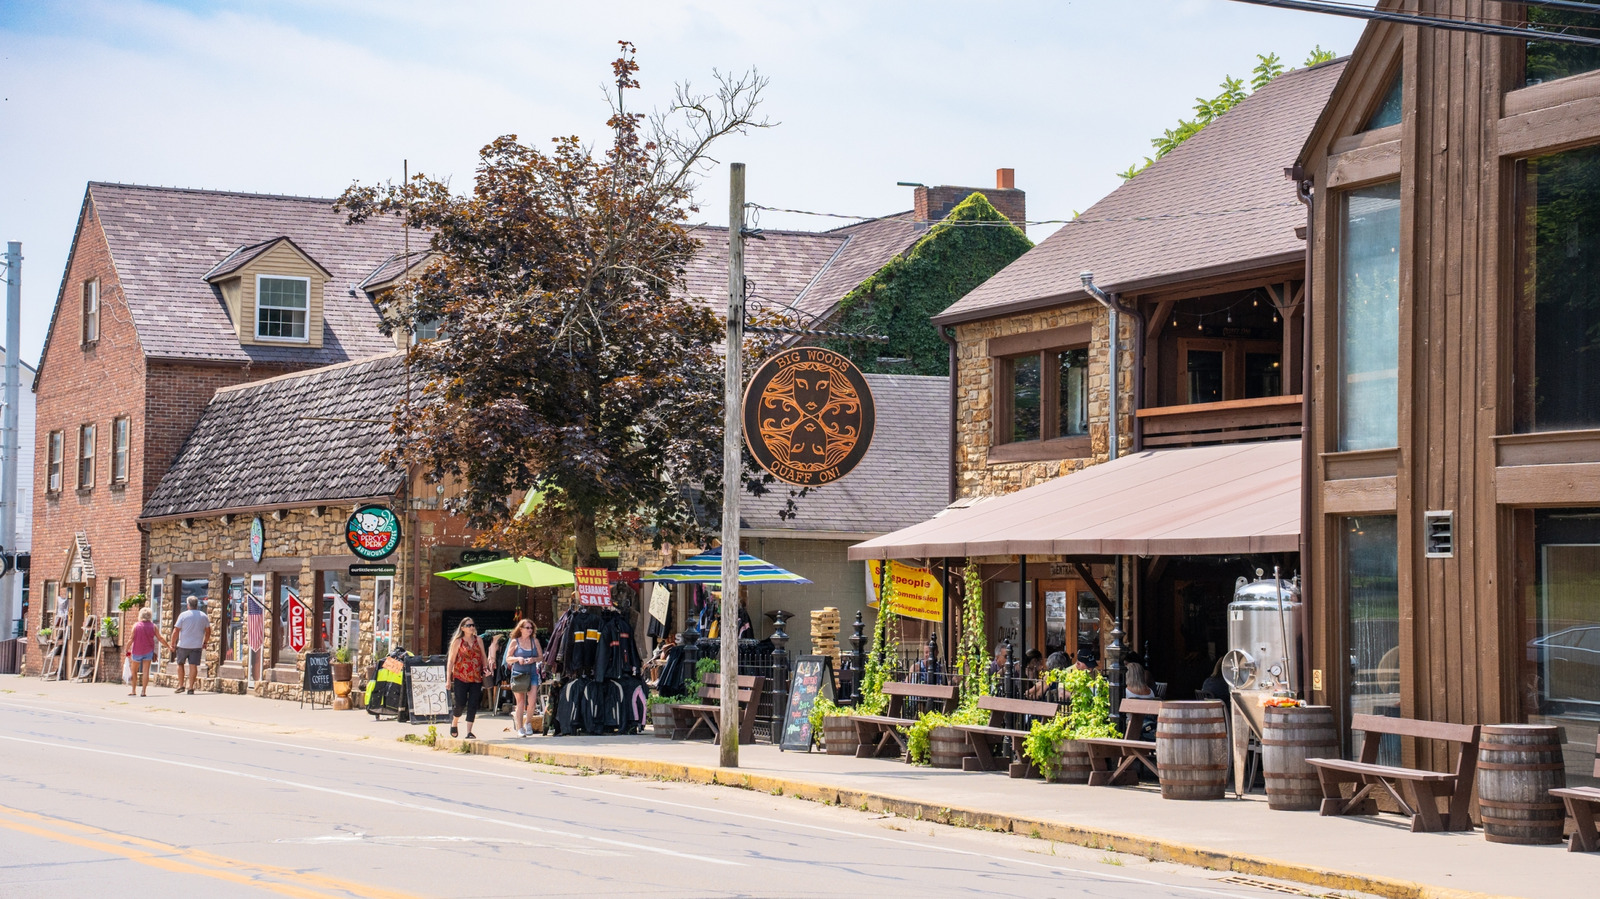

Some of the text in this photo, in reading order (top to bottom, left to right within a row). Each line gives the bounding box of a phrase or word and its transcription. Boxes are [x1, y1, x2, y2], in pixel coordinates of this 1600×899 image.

[775, 350, 850, 372] BIG WOODS
[769, 461, 841, 483] QUAFF ON!
[356, 530, 397, 557] ARTHOUSE COFFEE
[360, 534, 388, 542] PERCY'S
[576, 568, 607, 577] STORE
[577, 576, 608, 585] WIDE
[578, 584, 609, 596] CLEARANCE
[580, 595, 612, 606] SALE
[291, 605, 304, 647] OPEN
[311, 674, 330, 684] COFFEE
